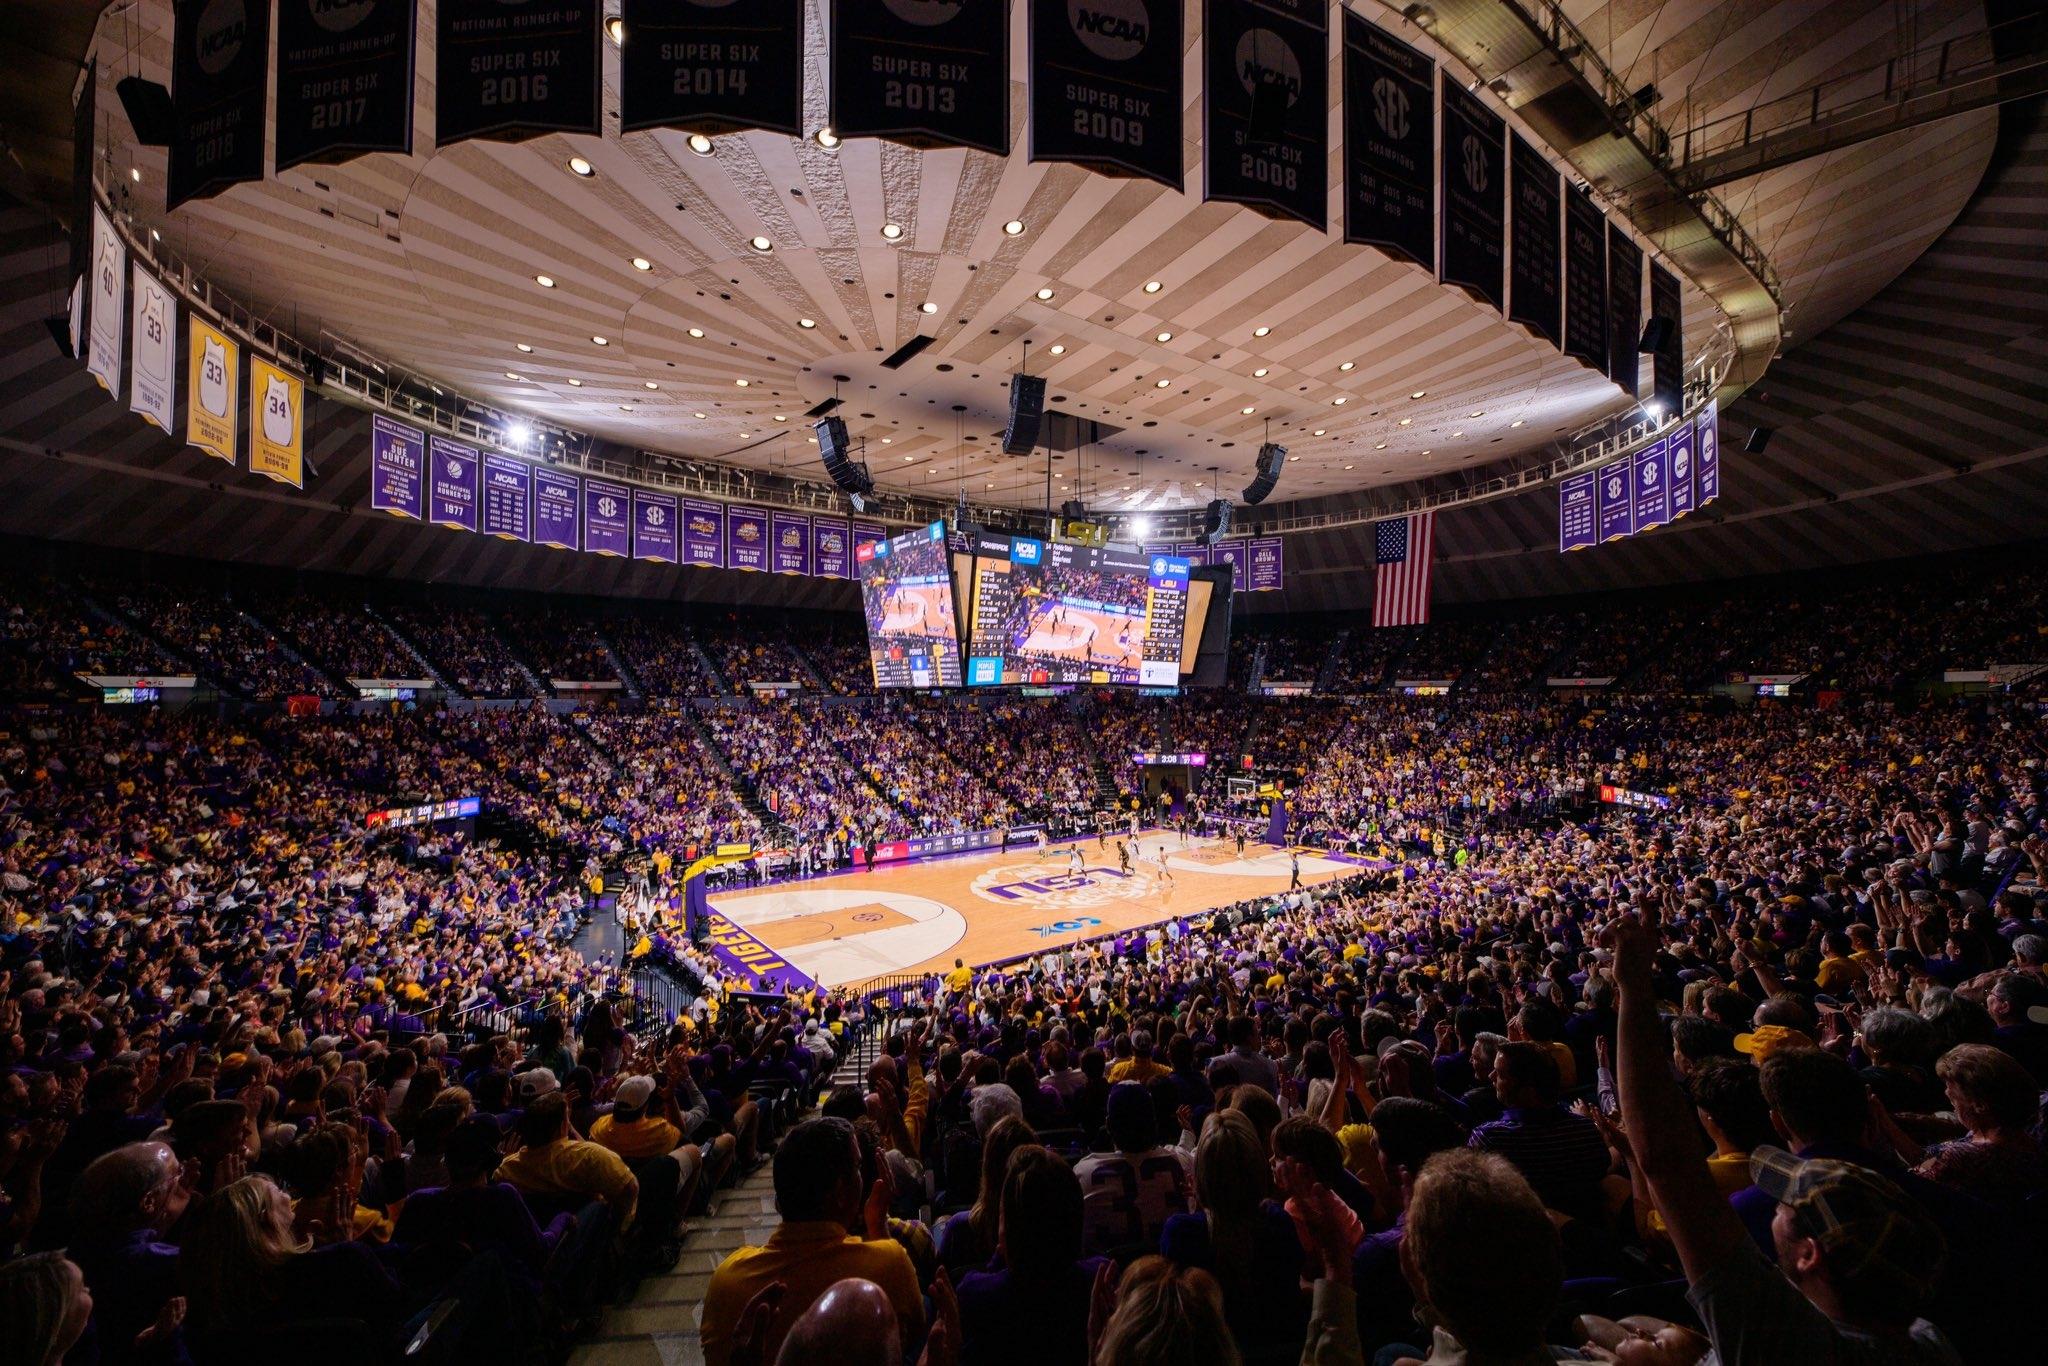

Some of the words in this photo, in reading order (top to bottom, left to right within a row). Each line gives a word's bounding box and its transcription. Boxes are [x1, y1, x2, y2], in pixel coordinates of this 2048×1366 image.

[452, 16, 508, 32] NATIONAL
[513, 9, 581, 27] RUNNER-UP
[1077, 9, 1146, 46] NCAA
[470, 51, 526, 73] SUPER
[532, 49, 561, 68] SIX
[660, 42, 722, 62] SUPER
[728, 43, 760, 63] SIX
[871, 54, 932, 78] SUPER
[938, 63, 968, 83] SIX
[302, 77, 349, 100] SUPER
[354, 72, 379, 93] SIX
[480, 73, 549, 106] 2016
[673, 67, 748, 97] 2014
[884, 80, 956, 114] 2013
[1065, 83, 1119, 111] SUPER
[1124, 97, 1150, 118] SIX
[1371, 76, 1410, 140] SEC
[311, 97, 366, 129] 2017
[1073, 108, 1144, 147] 2009
[195, 132, 235, 168] 2018
[1281, 145, 1303, 165] SIX
[1241, 152, 1297, 192] 2008
[102, 266, 113, 298] 40
[147, 315, 161, 345] 33
[206, 360, 222, 386] 33
[269, 396, 286, 418] 34
[382, 449, 415, 469] GUNTER
[391, 444, 407, 457] SUE
[495, 472, 518, 485] NCAA
[437, 487, 471, 501] RUNNER-UP
[546, 486, 568, 498] NCAA
[1568, 489, 1586, 502] NCAA
[444, 503, 464, 517] 1977
[598, 497, 617, 518] SEC
[646, 505, 665, 526] SEC
[1056, 517, 1108, 547] LSU
[693, 550, 713, 559] 2004
[738, 554, 758, 563] 2005
[1014, 542, 1037, 555] NCAA
[823, 563, 840, 571] 2007
[1160, 579, 1177, 588] LSU
[1062, 672, 1079, 682] 3:08
[1161, 754, 1177, 763] 3:08
[986, 868, 1133, 899] LSU
[709, 914, 785, 976] TIGERS
